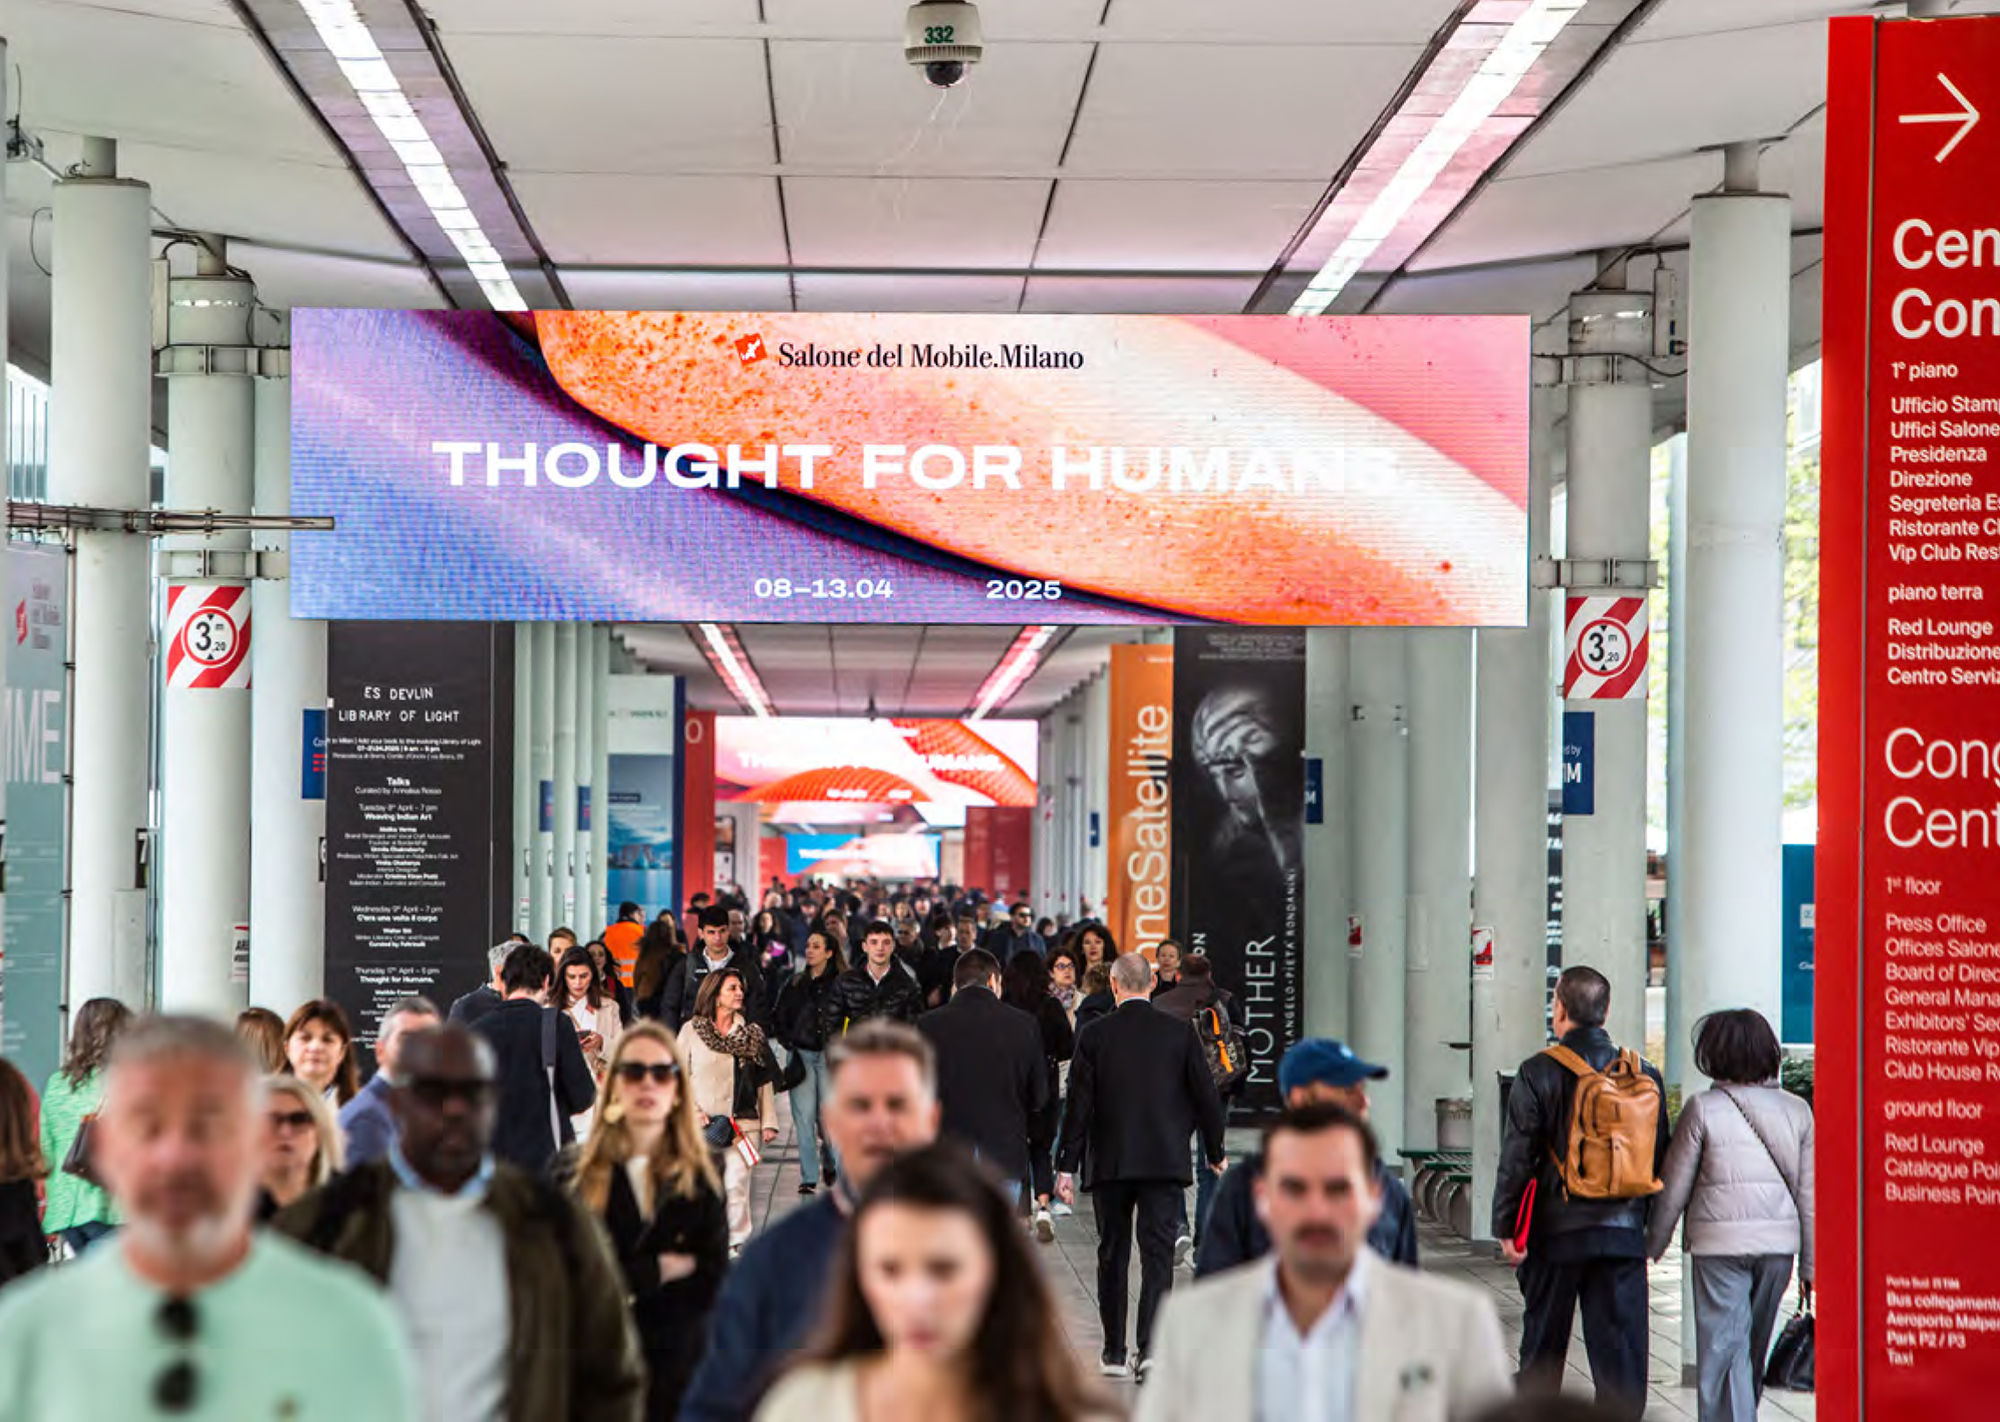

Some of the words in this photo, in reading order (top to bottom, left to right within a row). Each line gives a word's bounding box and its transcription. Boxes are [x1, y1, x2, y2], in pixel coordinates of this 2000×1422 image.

[924, 25, 954, 44] 332
[1892, 218, 2000, 270] Cen
[1891, 287, 2000, 340] Con
[777, 341, 861, 369] Salone
[866, 341, 903, 369] del
[1908, 361, 1959, 382] piano
[1890, 396, 1949, 414] Ufficio
[1951, 395, 2000, 414] Stam
[1890, 420, 1937, 438] Uffici
[1940, 420, 2000, 438] Salone
[1890, 445, 1988, 464] Presidenza
[431, 440, 832, 490] THOUGHT
[862, 443, 1024, 491] FOR
[1889, 470, 1974, 489] Direzione
[1888, 494, 1982, 516] Segreteria
[1888, 518, 1980, 538] Ristorante
[1888, 543, 1917, 564] Vip
[1920, 542, 1962, 562] Club
[985, 579, 1062, 600] 2025
[1887, 582, 1938, 604] piano
[1940, 583, 1984, 601] terra
[195, 620, 212, 652] 3
[1887, 618, 1923, 636] Red
[1926, 619, 1994, 639] Lounge
[1588, 631, 1605, 663] 3
[1607, 634, 1618, 642] m
[1887, 667, 1948, 685] Centro
[364, 686, 381, 700] ES
[389, 687, 434, 701] DEVLIN
[338, 709, 392, 723] LIBRARY
[399, 710, 416, 723] OF
[424, 710, 460, 723] LIGHT
[386, 777, 411, 786] Talks
[1904, 876, 1943, 895] floor
[1885, 912, 1934, 933] Press
[1936, 912, 1988, 935] Office
[1884, 937, 1945, 958] Offices
[1885, 961, 1935, 982] Board
[1938, 962, 1955, 982] of
[1884, 986, 1950, 1007] General
[1244, 934, 1277, 1083] MOTHER
[1885, 1034, 1970, 1056] Ristorante
[1884, 1058, 1924, 1079] Club
[1926, 1060, 1982, 1081] House
[1884, 1098, 1944, 1120] ground
[1946, 1098, 1984, 1120] floor
[1884, 1131, 1919, 1153] Red
[1921, 1132, 1985, 1158] Lounge
[1884, 1155, 1970, 1182] Catalogue
[1885, 1181, 1961, 1204] Business
[1886, 1290, 1912, 1308] Bus
[1885, 1309, 1954, 1329] Aeroporto
[1886, 1328, 1917, 1347] Park
[1886, 1348, 1914, 1367] Taxi
